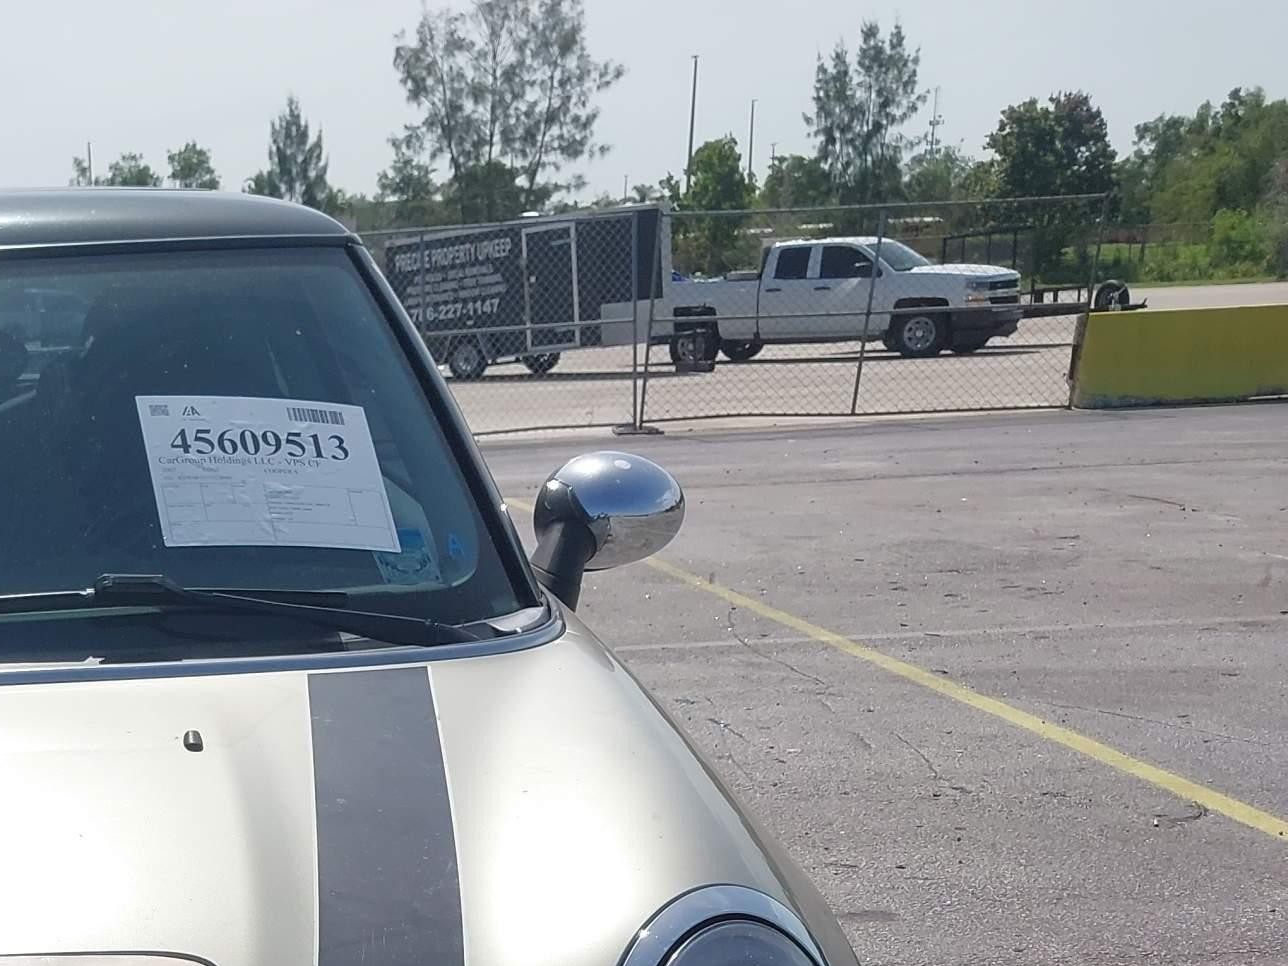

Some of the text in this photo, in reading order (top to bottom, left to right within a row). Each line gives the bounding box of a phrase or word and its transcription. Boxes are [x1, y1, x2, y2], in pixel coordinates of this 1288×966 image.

[476, 238, 511, 260] UPKEEP
[170, 428, 349, 461] 45609513
[158, 456, 206, 466] CarGroup
[208, 456, 252, 466] Holdings
[255, 457, 275, 466] LLC
